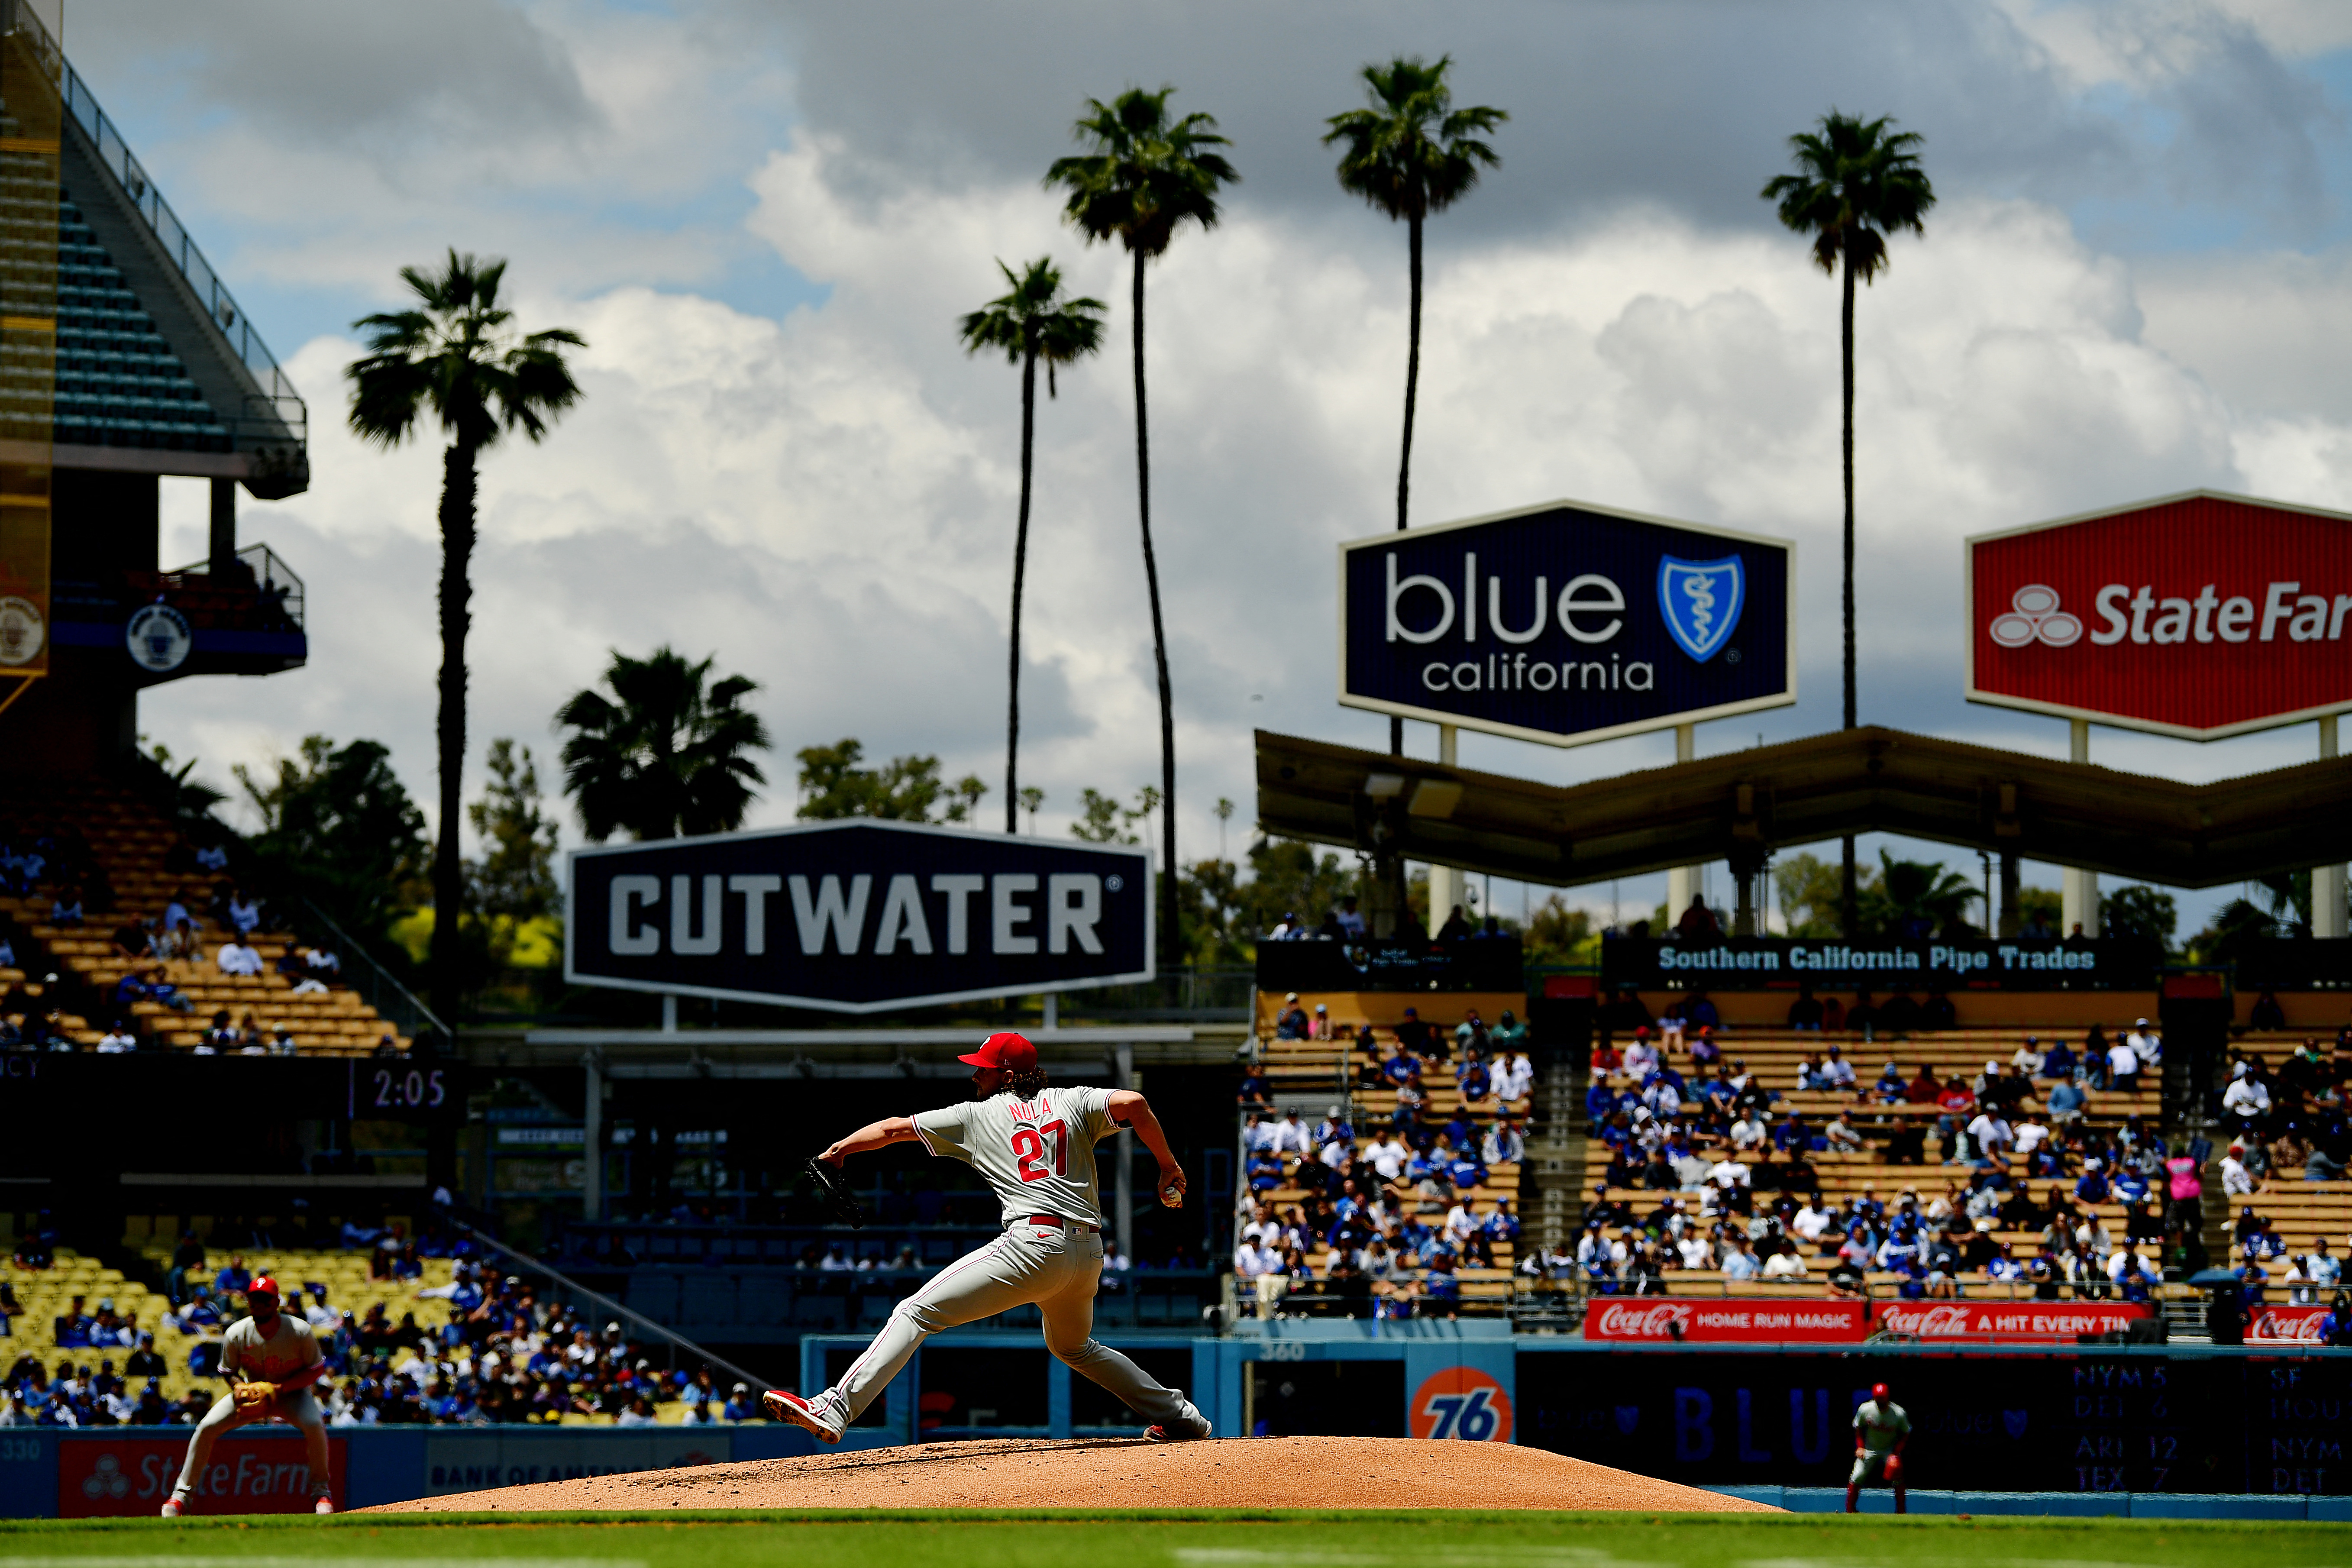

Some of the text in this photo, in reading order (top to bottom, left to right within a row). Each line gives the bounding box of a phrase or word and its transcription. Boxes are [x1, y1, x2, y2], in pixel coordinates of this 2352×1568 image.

[1386, 553, 1625, 644] blue
[2090, 581, 2352, 646] StateFar
[1422, 653, 1654, 692] california
[609, 874, 1104, 955] CUTWATER
[1658, 946, 2097, 975] Southern California Pipe Trades
[0, 1054, 42, 1080] CY
[373, 1068, 447, 1109] 2:05
[1008, 1097, 1053, 1123] NOLA
[1009, 1117, 1069, 1184] 27
[1599, 1303, 1852, 1336] Coca-Cola HOME RUN MAGIC
[1977, 1314, 1992, 1331] A
[1995, 1315, 2029, 1332] HIT
[2032, 1315, 2096, 1332] EVERY
[2100, 1316, 2132, 1332] TIM
[1259, 1343, 1306, 1362] 360
[2072, 1364, 2167, 1389] NYM 5
[2270, 1366, 2302, 1391] SF
[1422, 1386, 1502, 1441] 76
[2151, 1394, 2168, 1419] 6
[2270, 1397, 2341, 1421] HOU
[1674, 1386, 1872, 1465] BLU
[1, 1438, 41, 1461] 330
[2074, 1435, 2178, 1460] ARI 12
[2271, 1436, 2342, 1461] NYM
[137, 1453, 310, 1500] StteFarm
[433, 1465, 502, 1487] BANK
[508, 1465, 541, 1484] OF
[2075, 1465, 2170, 1491] TEX 7
[2272, 1468, 2327, 1493] DET
